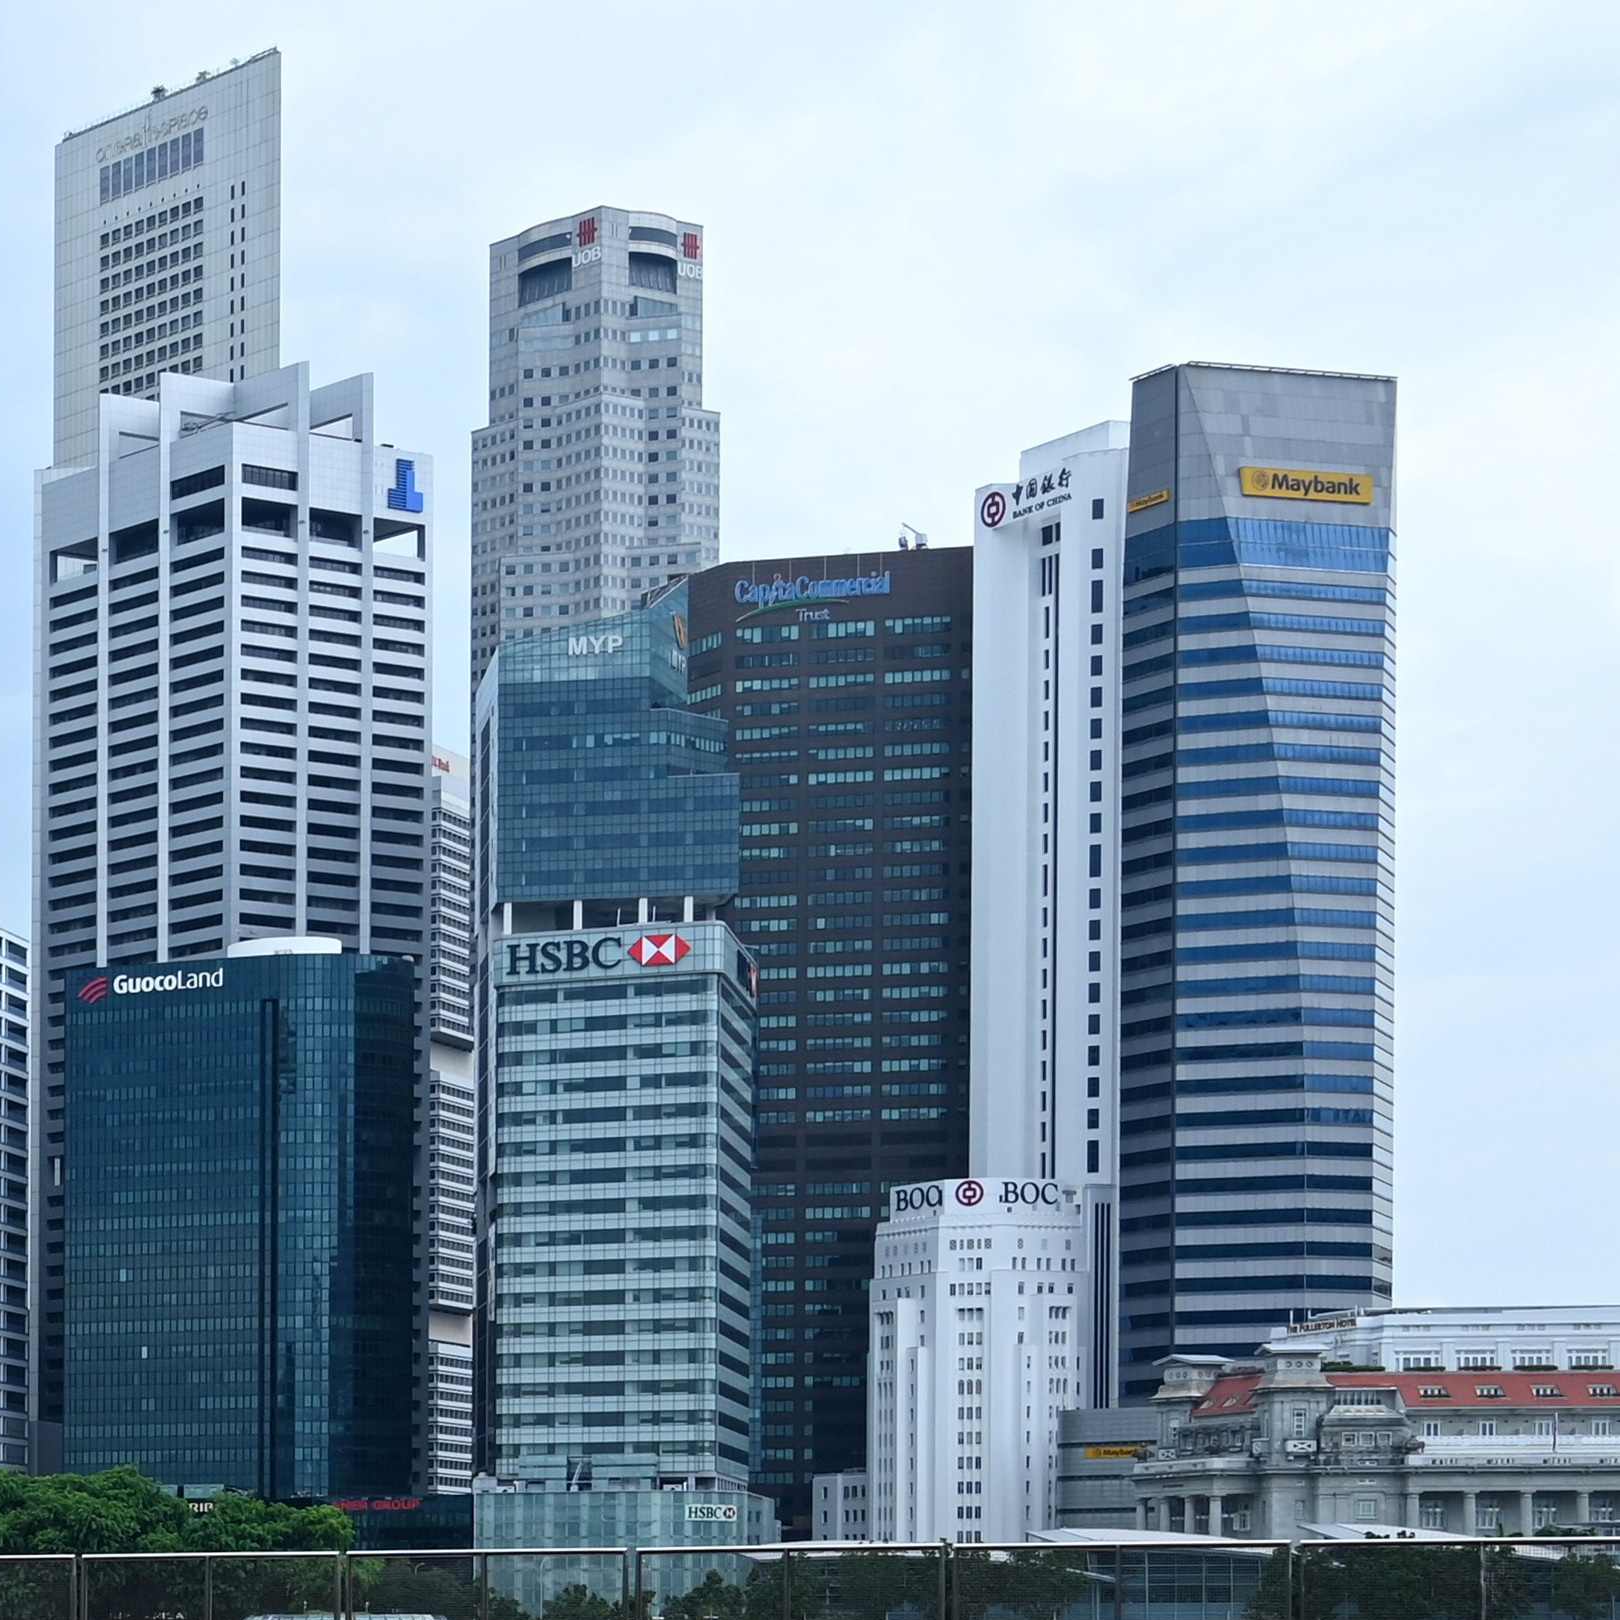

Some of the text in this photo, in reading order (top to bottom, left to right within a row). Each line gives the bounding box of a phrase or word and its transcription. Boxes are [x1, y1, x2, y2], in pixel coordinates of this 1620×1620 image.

[571, 246, 602, 268] UOB
[677, 262, 703, 280] UOB
[1271, 473, 1361, 497] Maybank
[1013, 493, 1072, 519] BANK OF CHINA
[734, 570, 891, 608] CapitaCommercial
[795, 608, 831, 622] Trust
[567, 635, 623, 656] MYP
[506, 936, 622, 976] HSBC
[113, 967, 224, 995] GuocoLand
[1002, 1181, 1059, 1205] BOC
[688, 1506, 722, 1520] HSBC
